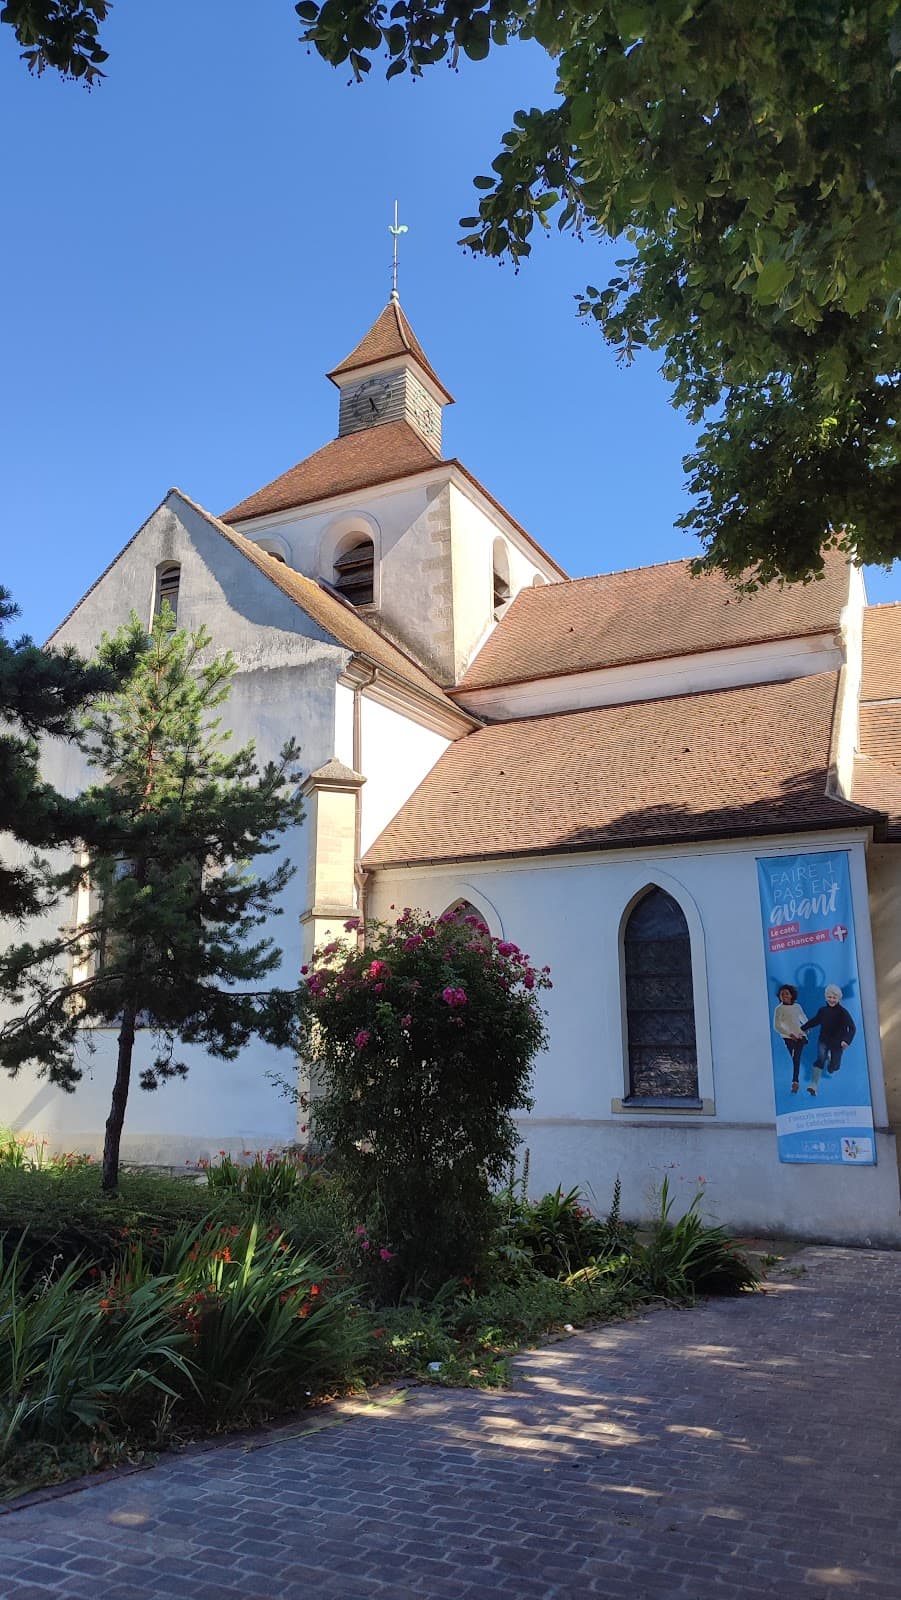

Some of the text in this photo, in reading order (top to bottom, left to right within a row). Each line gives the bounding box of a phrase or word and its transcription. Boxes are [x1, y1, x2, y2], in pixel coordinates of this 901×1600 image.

[770, 860, 835, 886] FAIRE 1
[773, 875, 835, 903] PAS EN
[770, 882, 840, 925] avant
[770, 929, 779, 937] Le
[771, 933, 826, 951] une chance en
